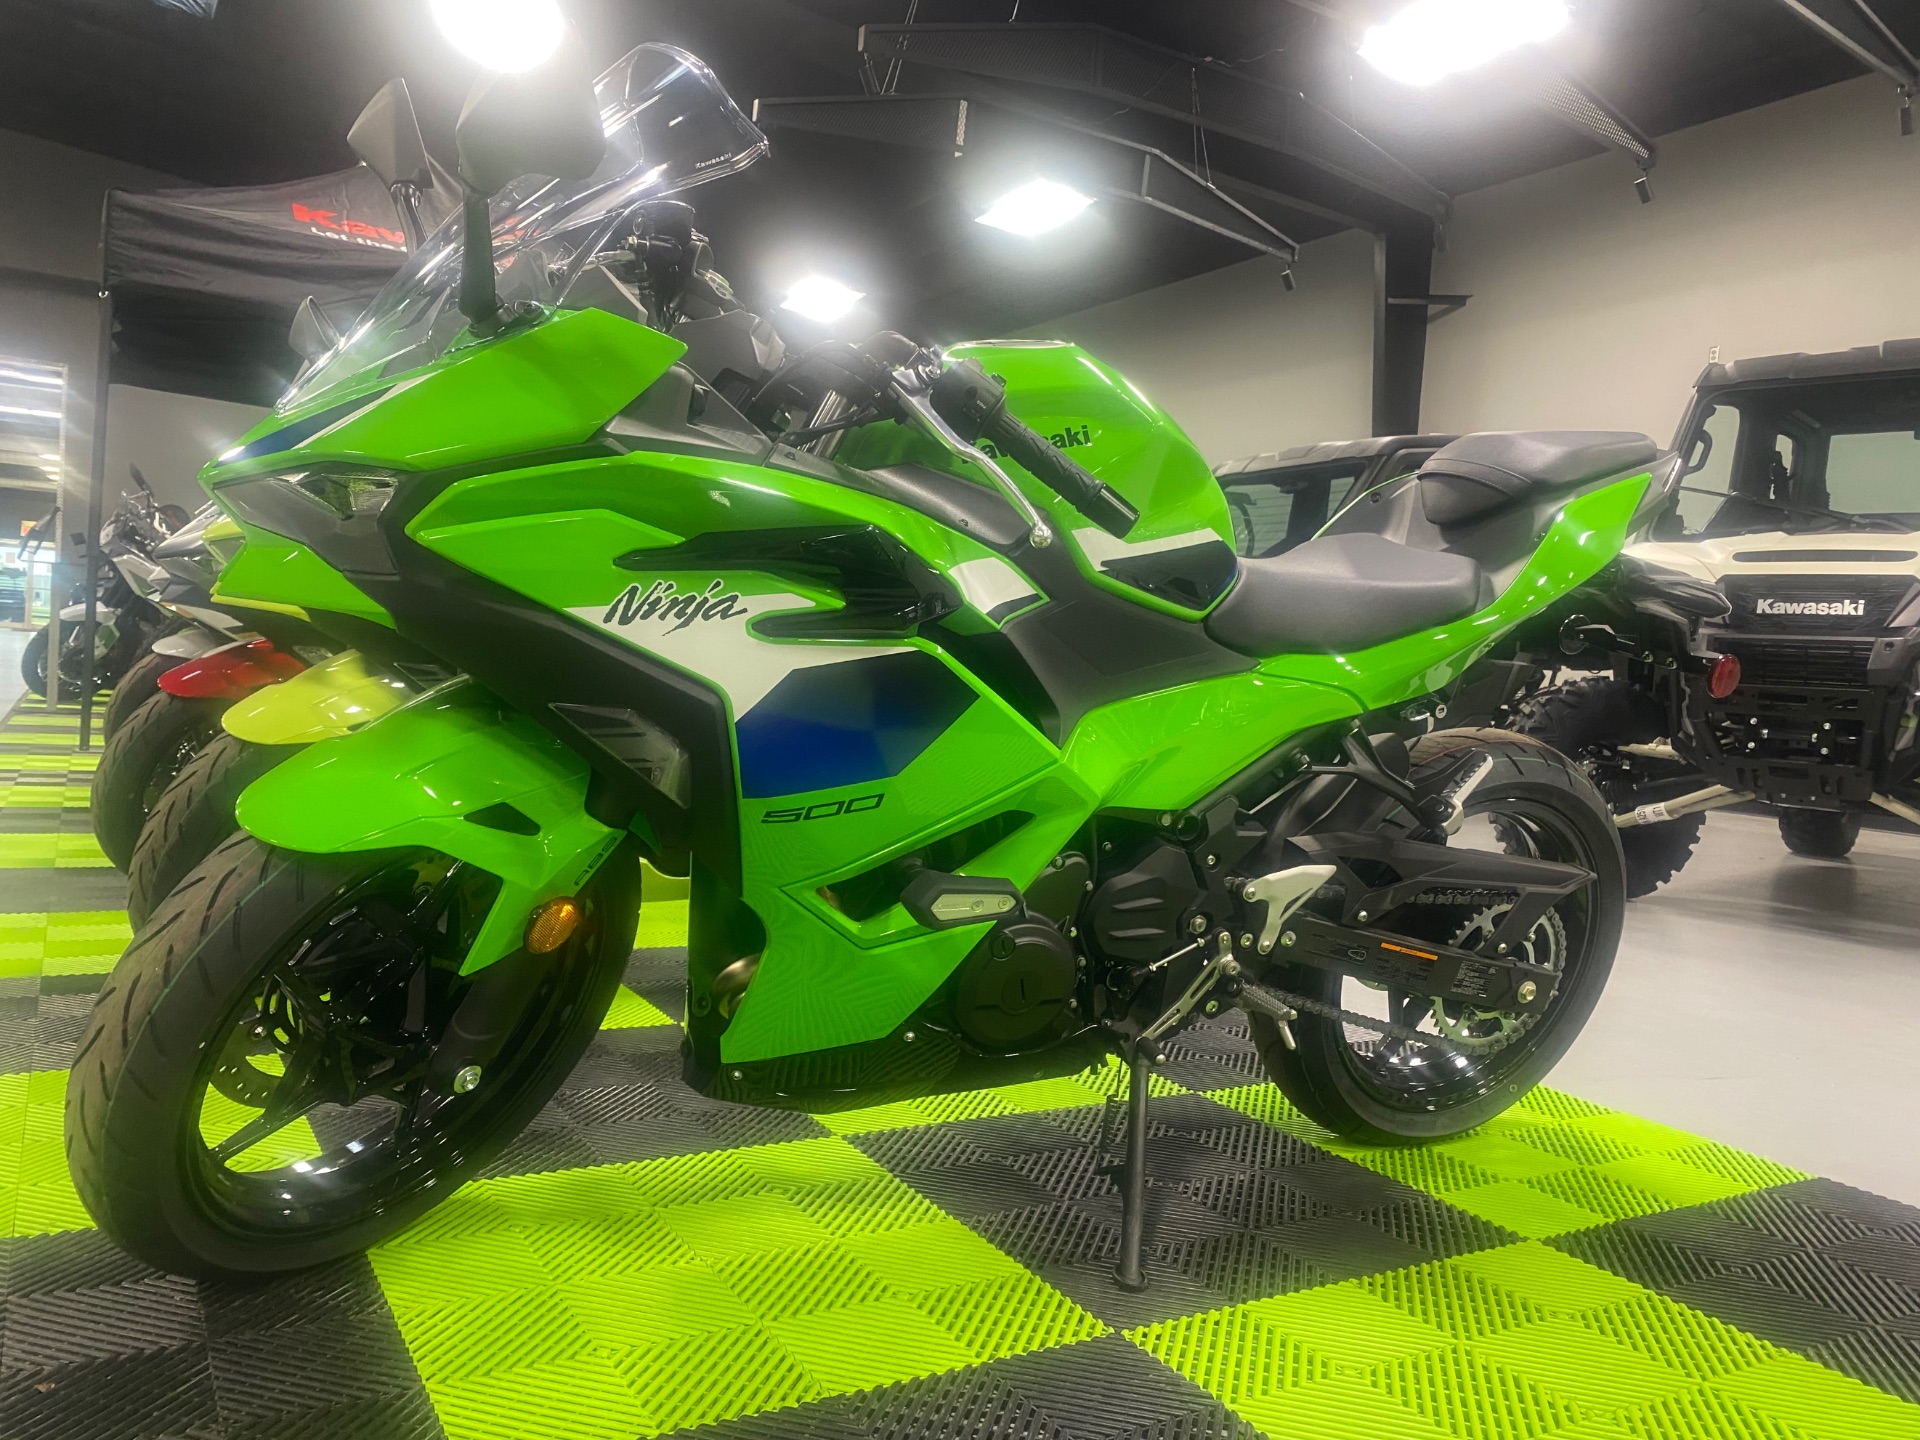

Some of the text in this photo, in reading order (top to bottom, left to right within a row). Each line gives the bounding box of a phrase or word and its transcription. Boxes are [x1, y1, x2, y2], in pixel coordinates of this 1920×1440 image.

[695, 152, 732, 169] Kawasaki
[311, 226, 349, 241] Let
[356, 237, 396, 250] the
[603, 580, 748, 637] Ninja
[1756, 599, 1865, 615] Kawasaki
[761, 793, 885, 823] 500
[573, 836, 618, 886] ABS
